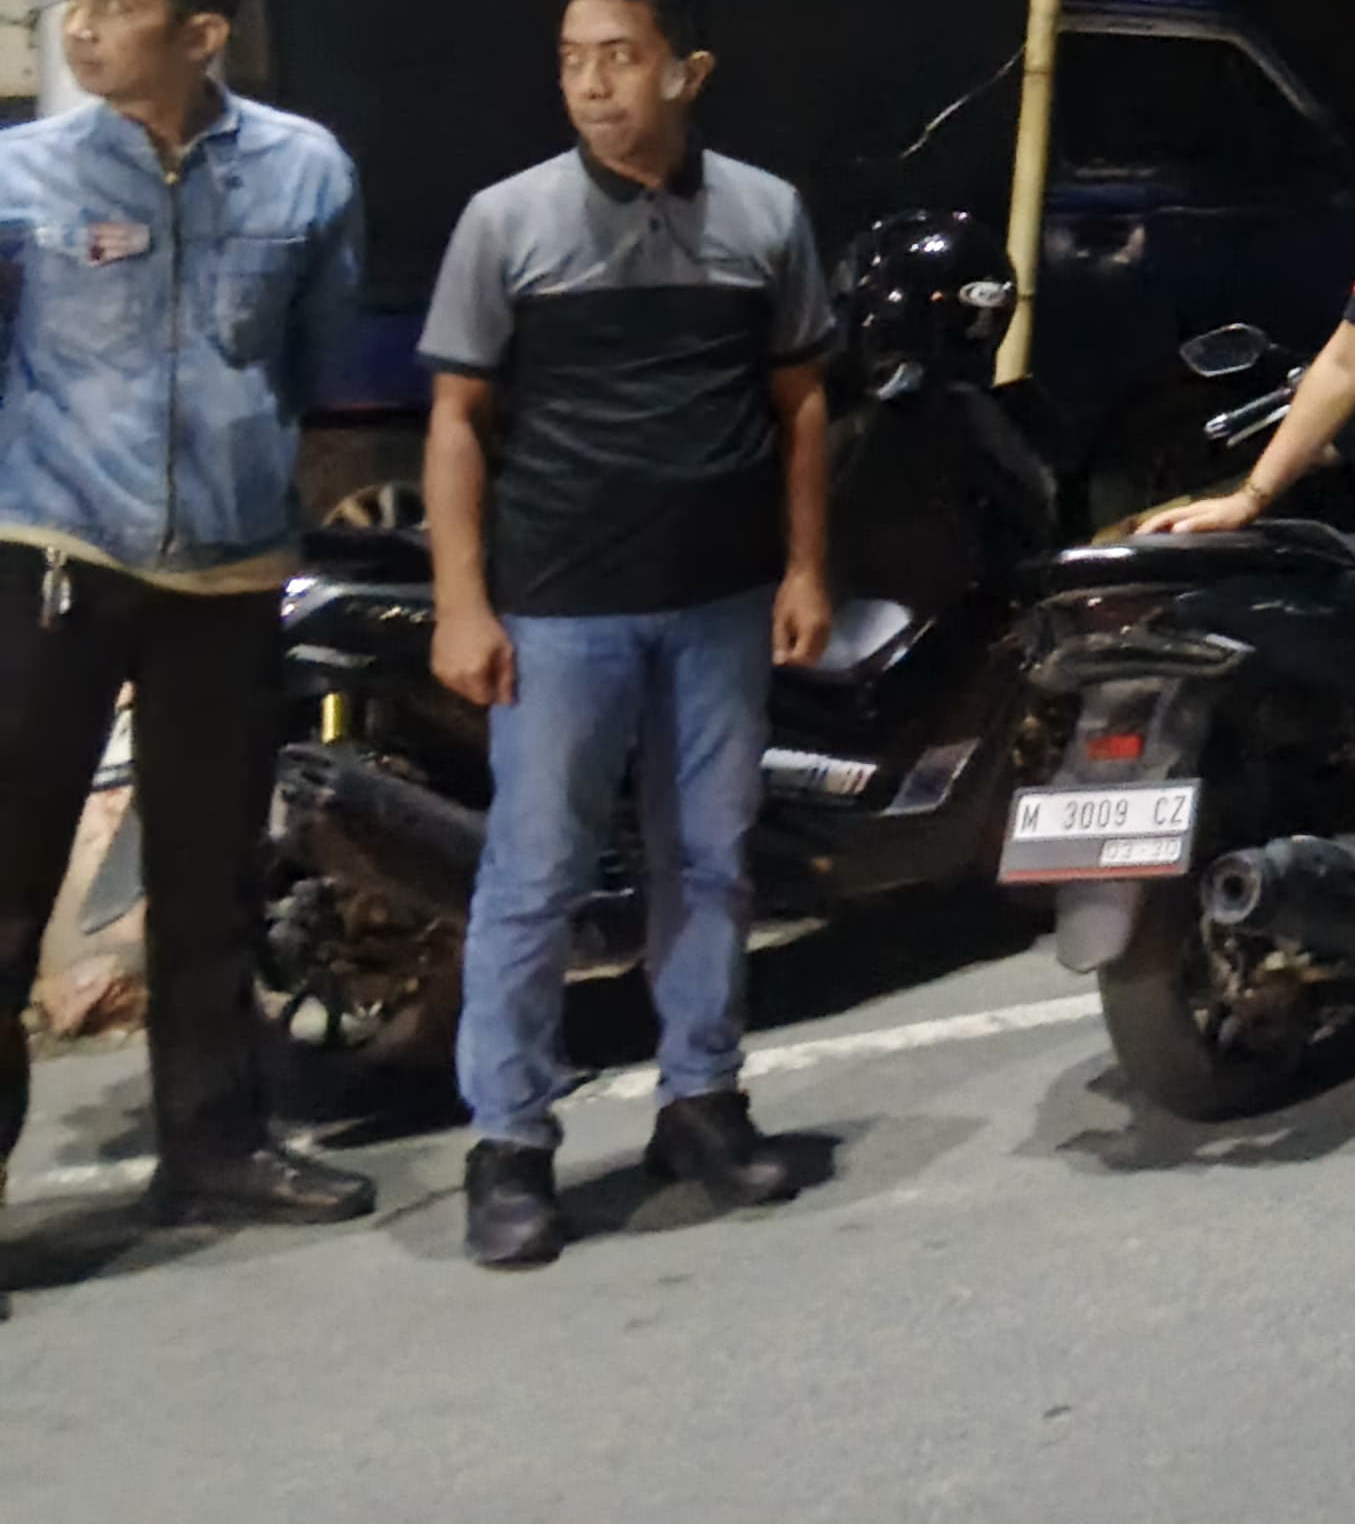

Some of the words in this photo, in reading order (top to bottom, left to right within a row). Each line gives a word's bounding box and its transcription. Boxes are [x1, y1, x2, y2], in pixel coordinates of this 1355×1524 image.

[1020, 804, 1041, 833] M
[1063, 798, 1130, 831] 3009
[1153, 794, 1187, 826] CZ
